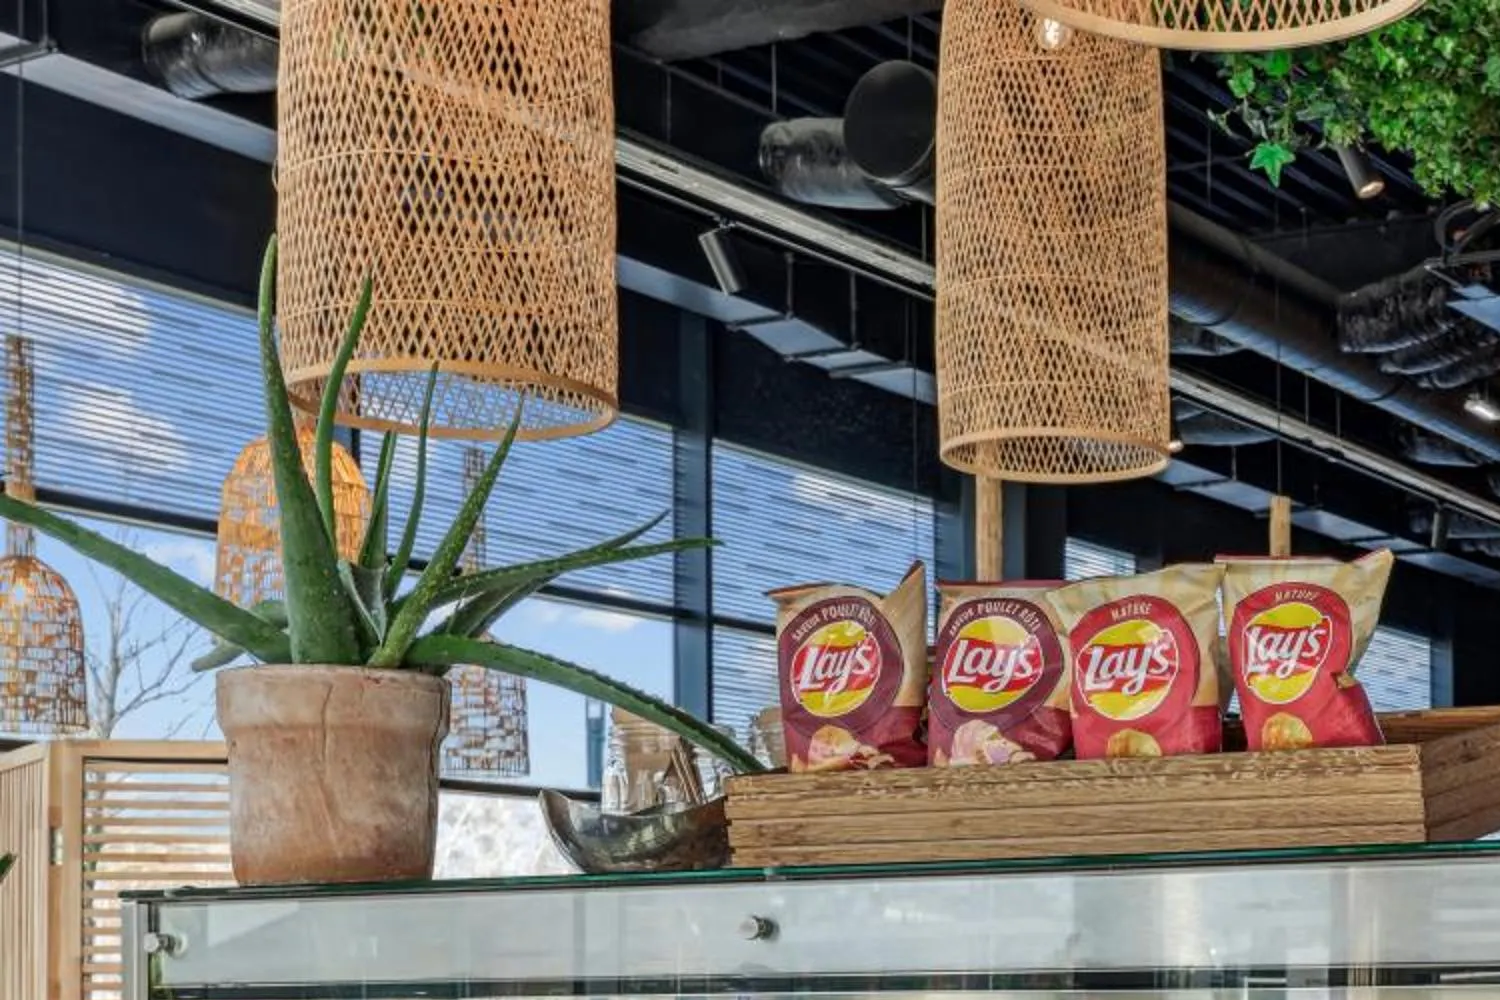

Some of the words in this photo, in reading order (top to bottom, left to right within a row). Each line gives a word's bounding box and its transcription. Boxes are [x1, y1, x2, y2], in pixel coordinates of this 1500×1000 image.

[977, 601, 1020, 615] POULET
[1110, 602, 1153, 621] NATURE
[799, 643, 874, 697] Lay's
[1083, 635, 1173, 697] Lay's
[1245, 622, 1329, 680] Lay's
